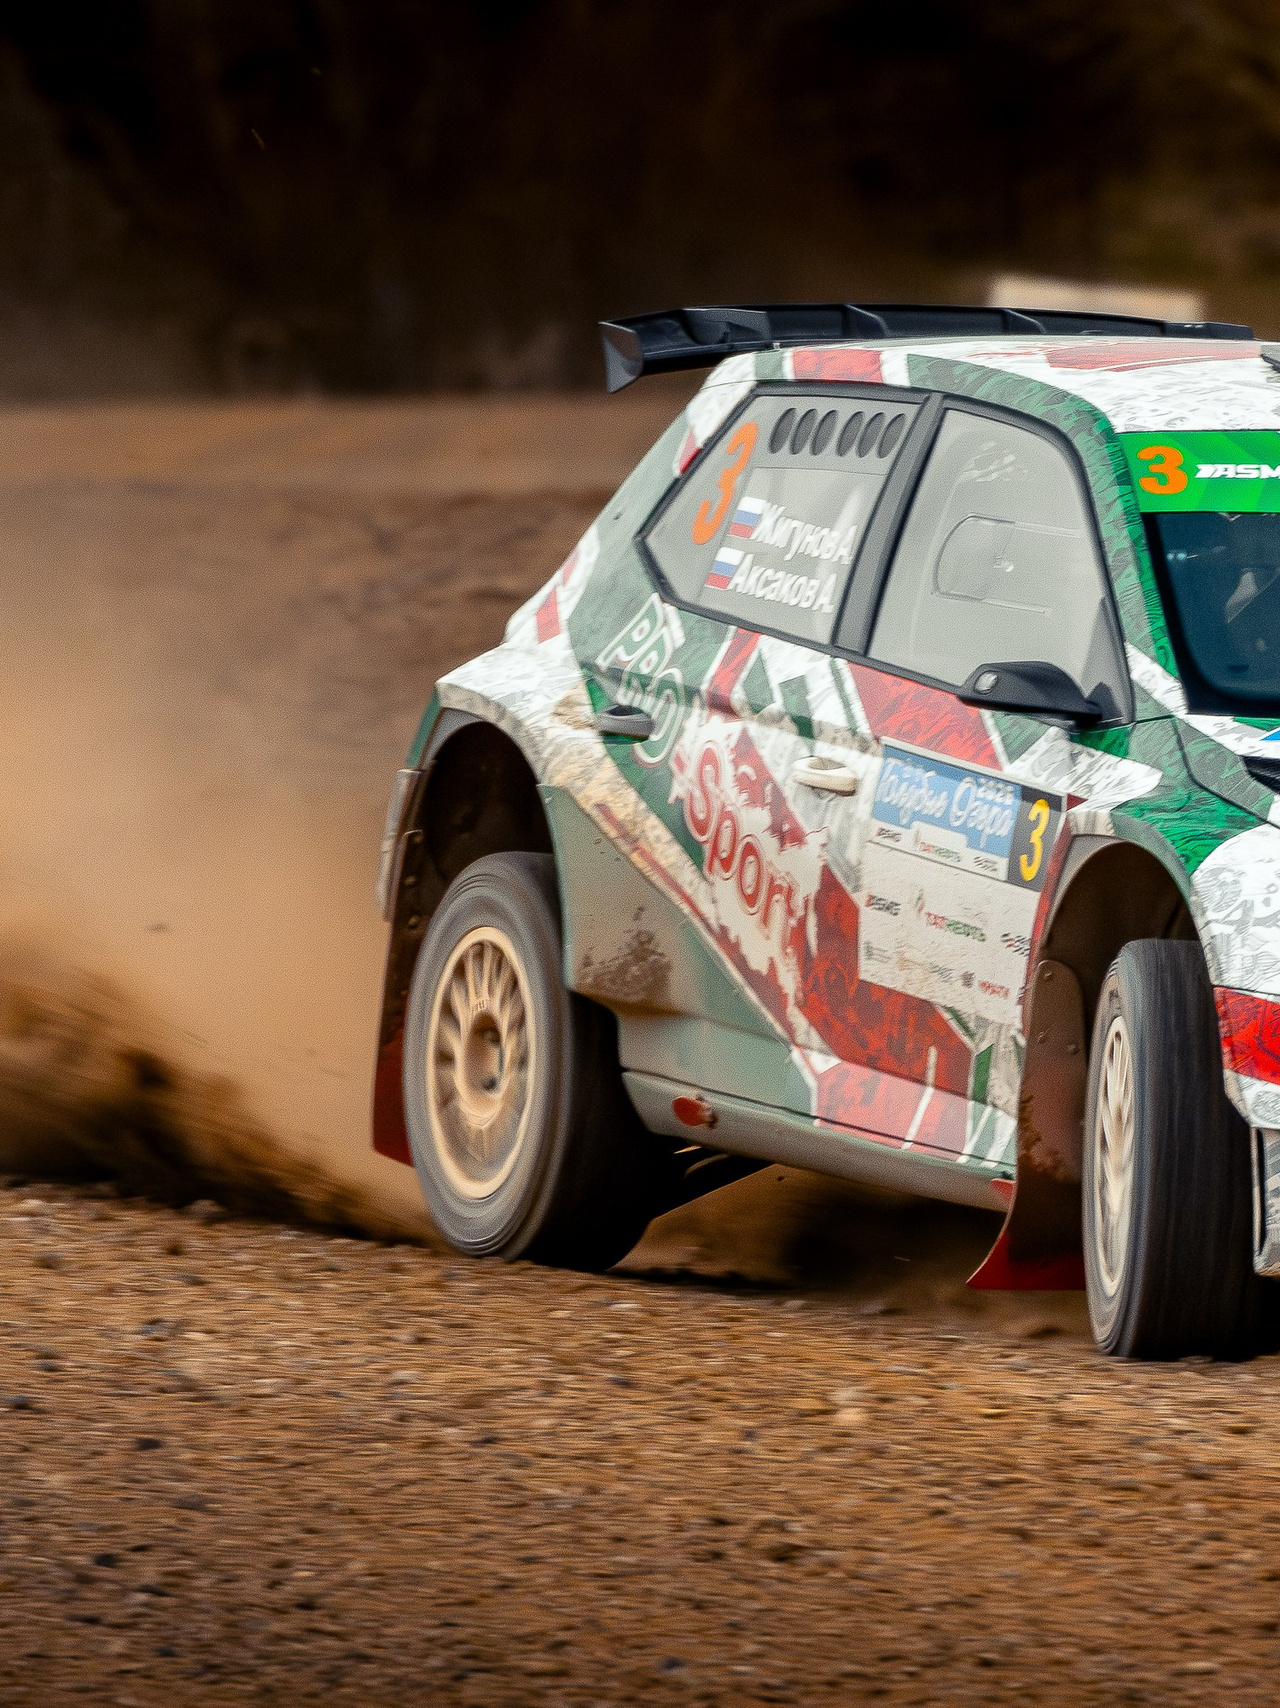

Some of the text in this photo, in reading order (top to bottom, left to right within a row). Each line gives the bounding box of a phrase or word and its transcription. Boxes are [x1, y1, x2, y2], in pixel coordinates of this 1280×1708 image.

[691, 420, 760, 545] 3
[1137, 445, 1189, 495] 3
[1019, 798, 1050, 882] 3
